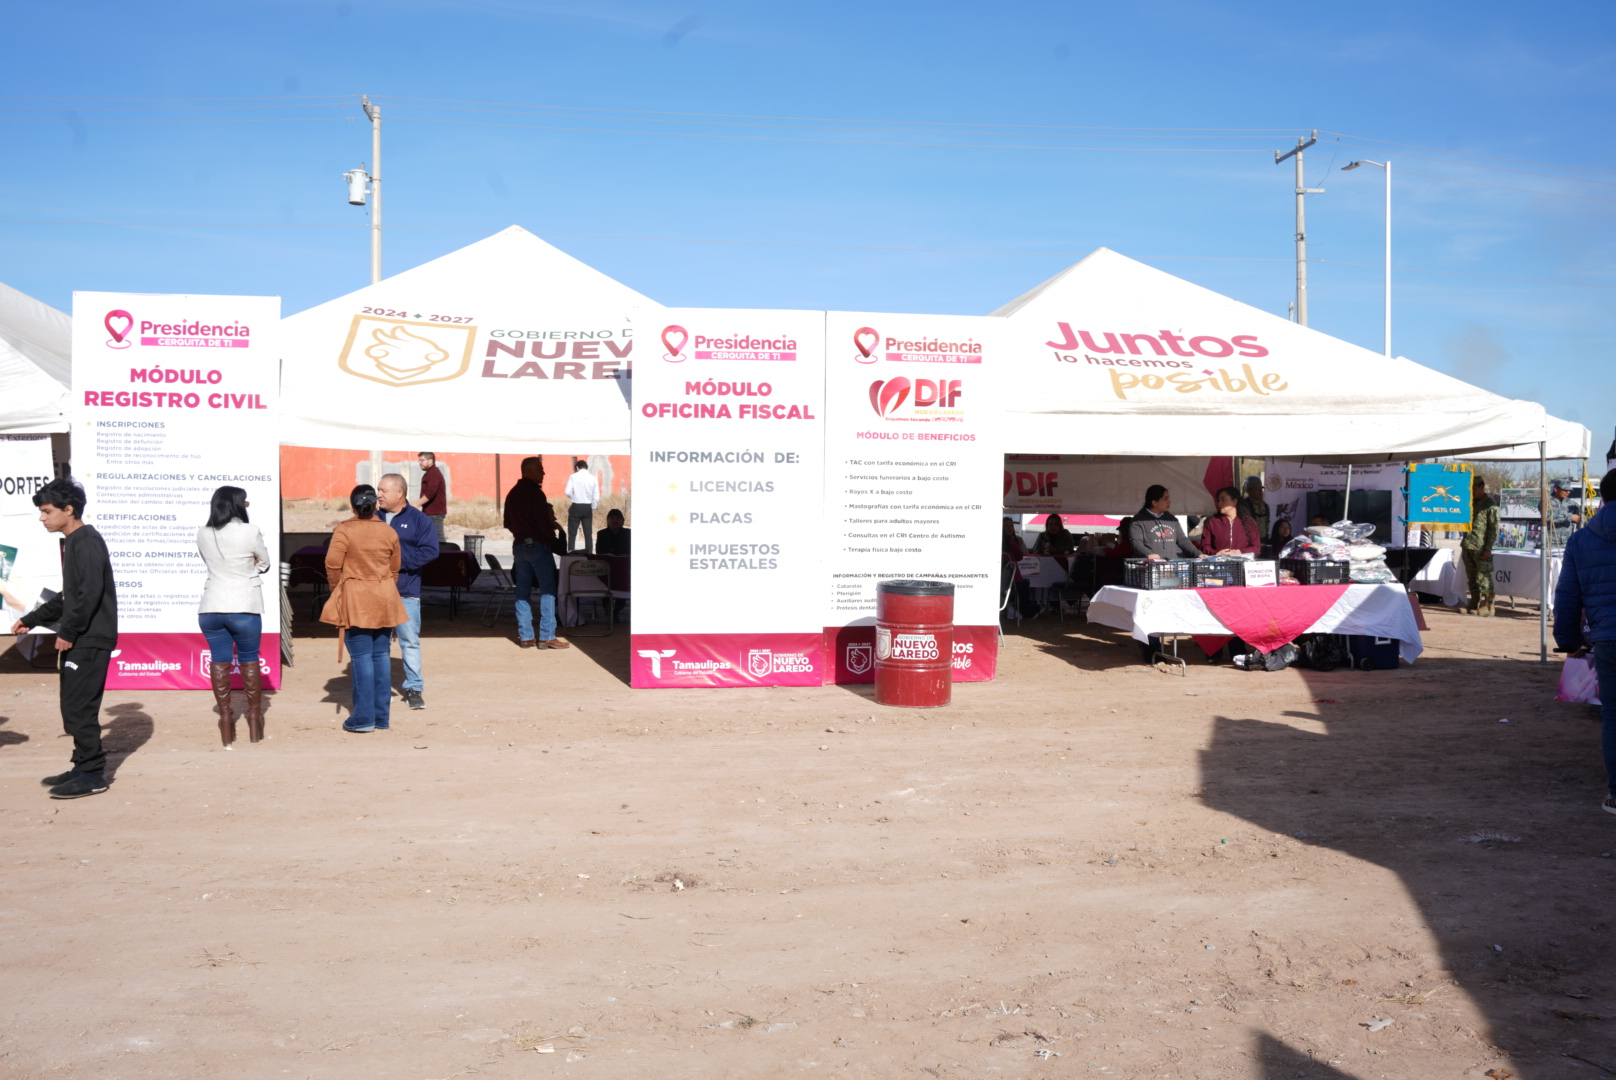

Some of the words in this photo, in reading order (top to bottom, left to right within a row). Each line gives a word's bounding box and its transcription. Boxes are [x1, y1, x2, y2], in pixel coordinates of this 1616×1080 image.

[362, 306, 407, 318] 2024
[429, 315, 474, 324] 2027
[140, 319, 250, 338] Presidencia
[490, 329, 613, 340] GOBIERNO
[622, 329, 632, 338] D
[158, 338, 206, 347] CERQUITA
[695, 333, 796, 350] Presidencia
[886, 336, 982, 353] Presidencia
[1045, 321, 1269, 358] Juntos
[486, 340, 632, 359] NUEV
[711, 352, 756, 360] CERQUITA
[1054, 352, 1077, 363] lo
[1085, 354, 1193, 368] hacemos
[130, 364, 222, 384] MÓDULO
[481, 360, 632, 379] LARE
[685, 378, 772, 396] MÓDULO
[1108, 363, 1288, 400] posible
[84, 390, 200, 408] REGISTRO
[208, 393, 268, 409] CIVIL
[915, 379, 962, 407] DIF
[642, 403, 732, 418] OFICINA
[739, 404, 815, 419] FISCAL
[856, 430, 899, 440] MÓDULO
[918, 433, 976, 441] BENEFICIOS
[650, 449, 764, 463] INFORMACIÓN
[774, 452, 800, 463] DE:
[0, 476, 49, 495] ORTES
[690, 481, 774, 492] LICENCIAS
[1016, 472, 1058, 496] DIF
[1285, 481, 1314, 489] México
[690, 512, 753, 524] PLACAS
[690, 544, 780, 555] IMPUESTOS
[690, 559, 777, 570] ESTATALES
[1496, 570, 1511, 583] GN
[894, 640, 936, 649] NUEVO
[952, 641, 973, 653] tos
[893, 650, 938, 658] LAREDO
[117, 660, 181, 672] Tamaulipas
[672, 660, 730, 671] Tamaulipas
